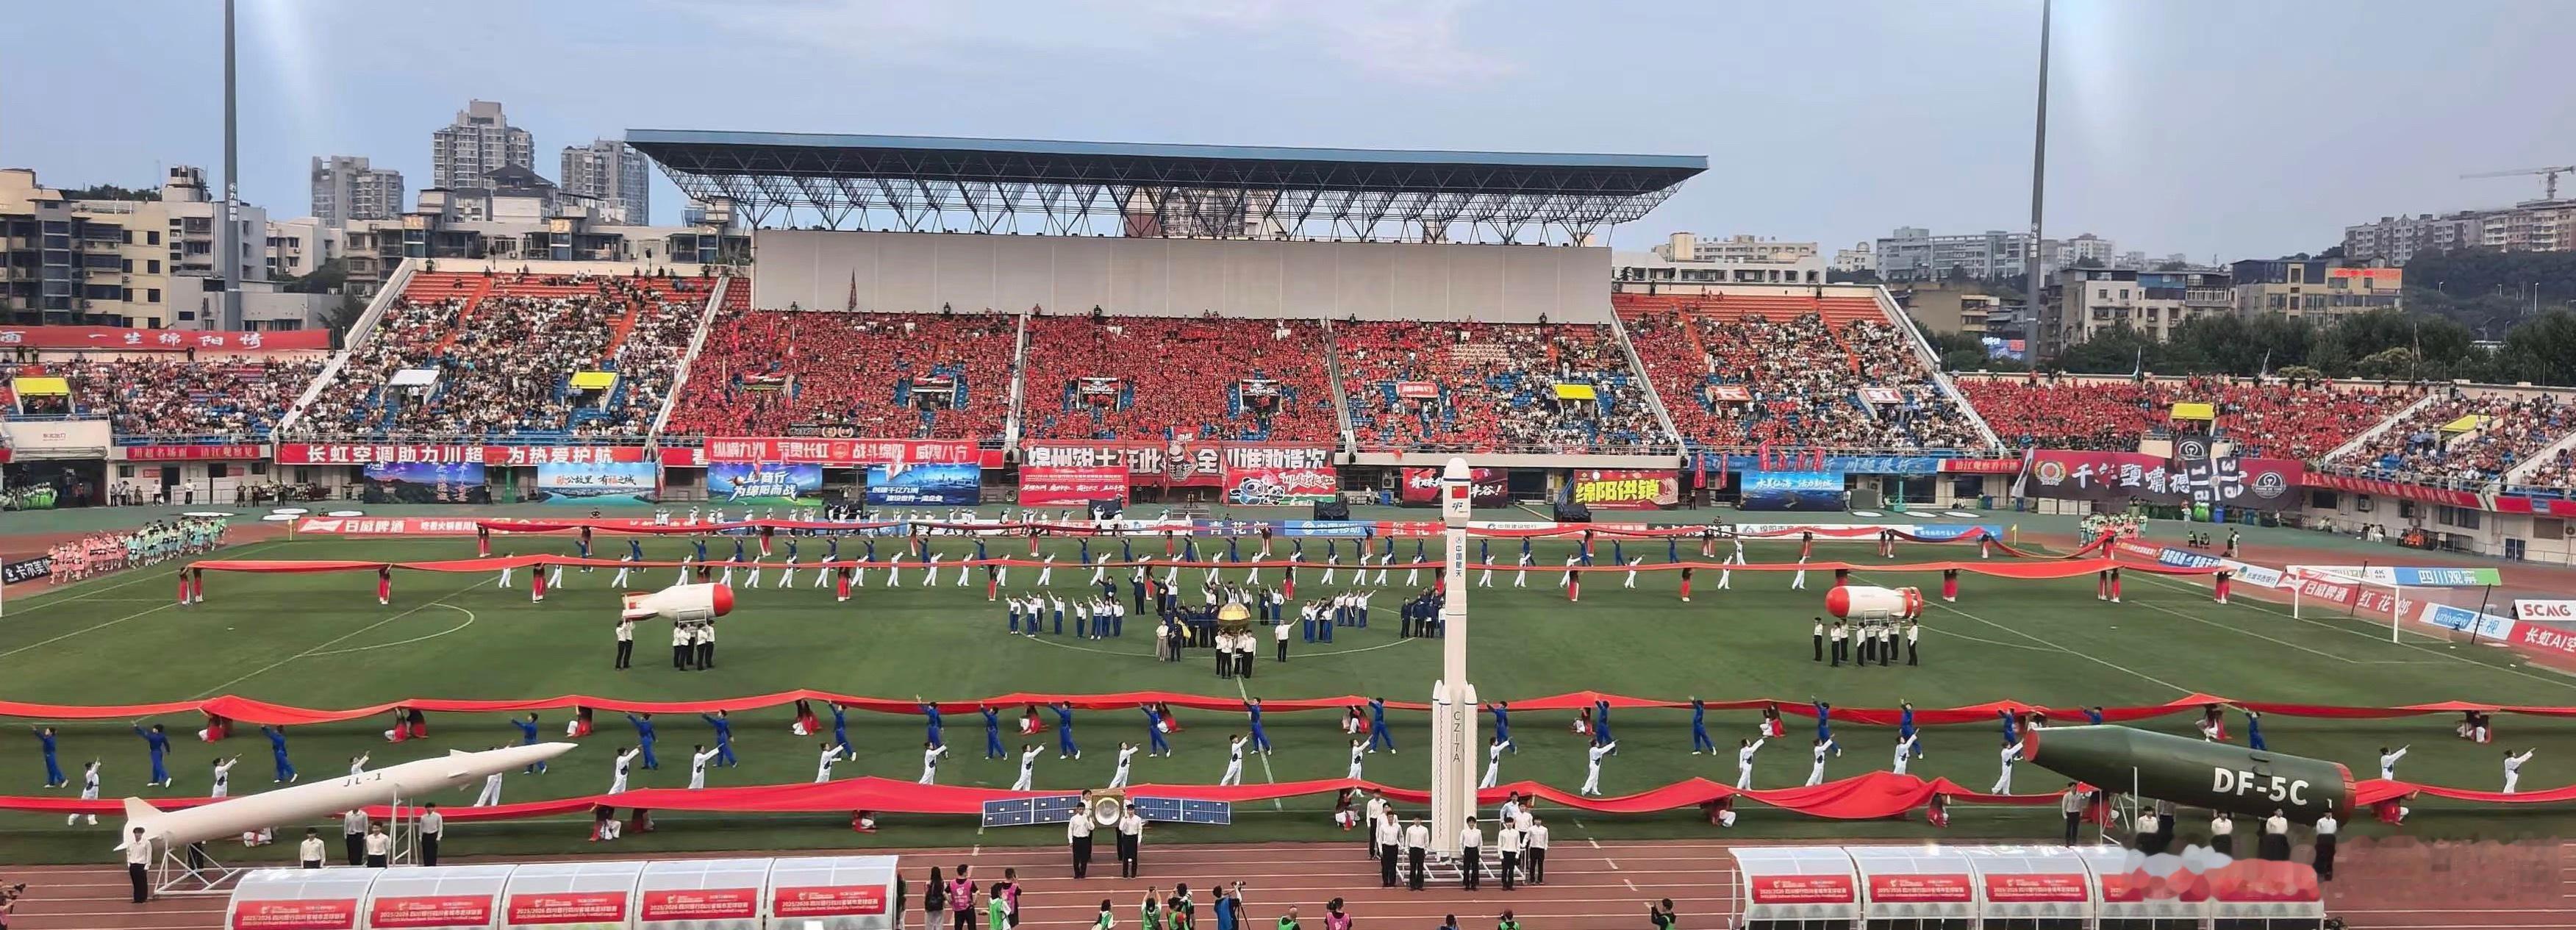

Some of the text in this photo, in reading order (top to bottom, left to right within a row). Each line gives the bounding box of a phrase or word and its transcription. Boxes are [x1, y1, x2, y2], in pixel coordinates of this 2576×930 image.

[88, 332, 264, 348] 一生绵阳情
[307, 446, 613, 464] 长虹空调助力川超 为热爱护航
[598, 474, 637, 485] 有福之城
[728, 484, 798, 501] 为绵阳而战
[1575, 479, 1660, 504] 绵阳供销
[344, 521, 405, 533] 百威啤酒
[2418, 570, 2478, 584] 四川观察
[2304, 580, 2350, 603] 百威啤酒
[2523, 603, 2572, 617] SCMG
[343, 773, 382, 787] JL-1
[2212, 767, 2310, 806] DF-5C
